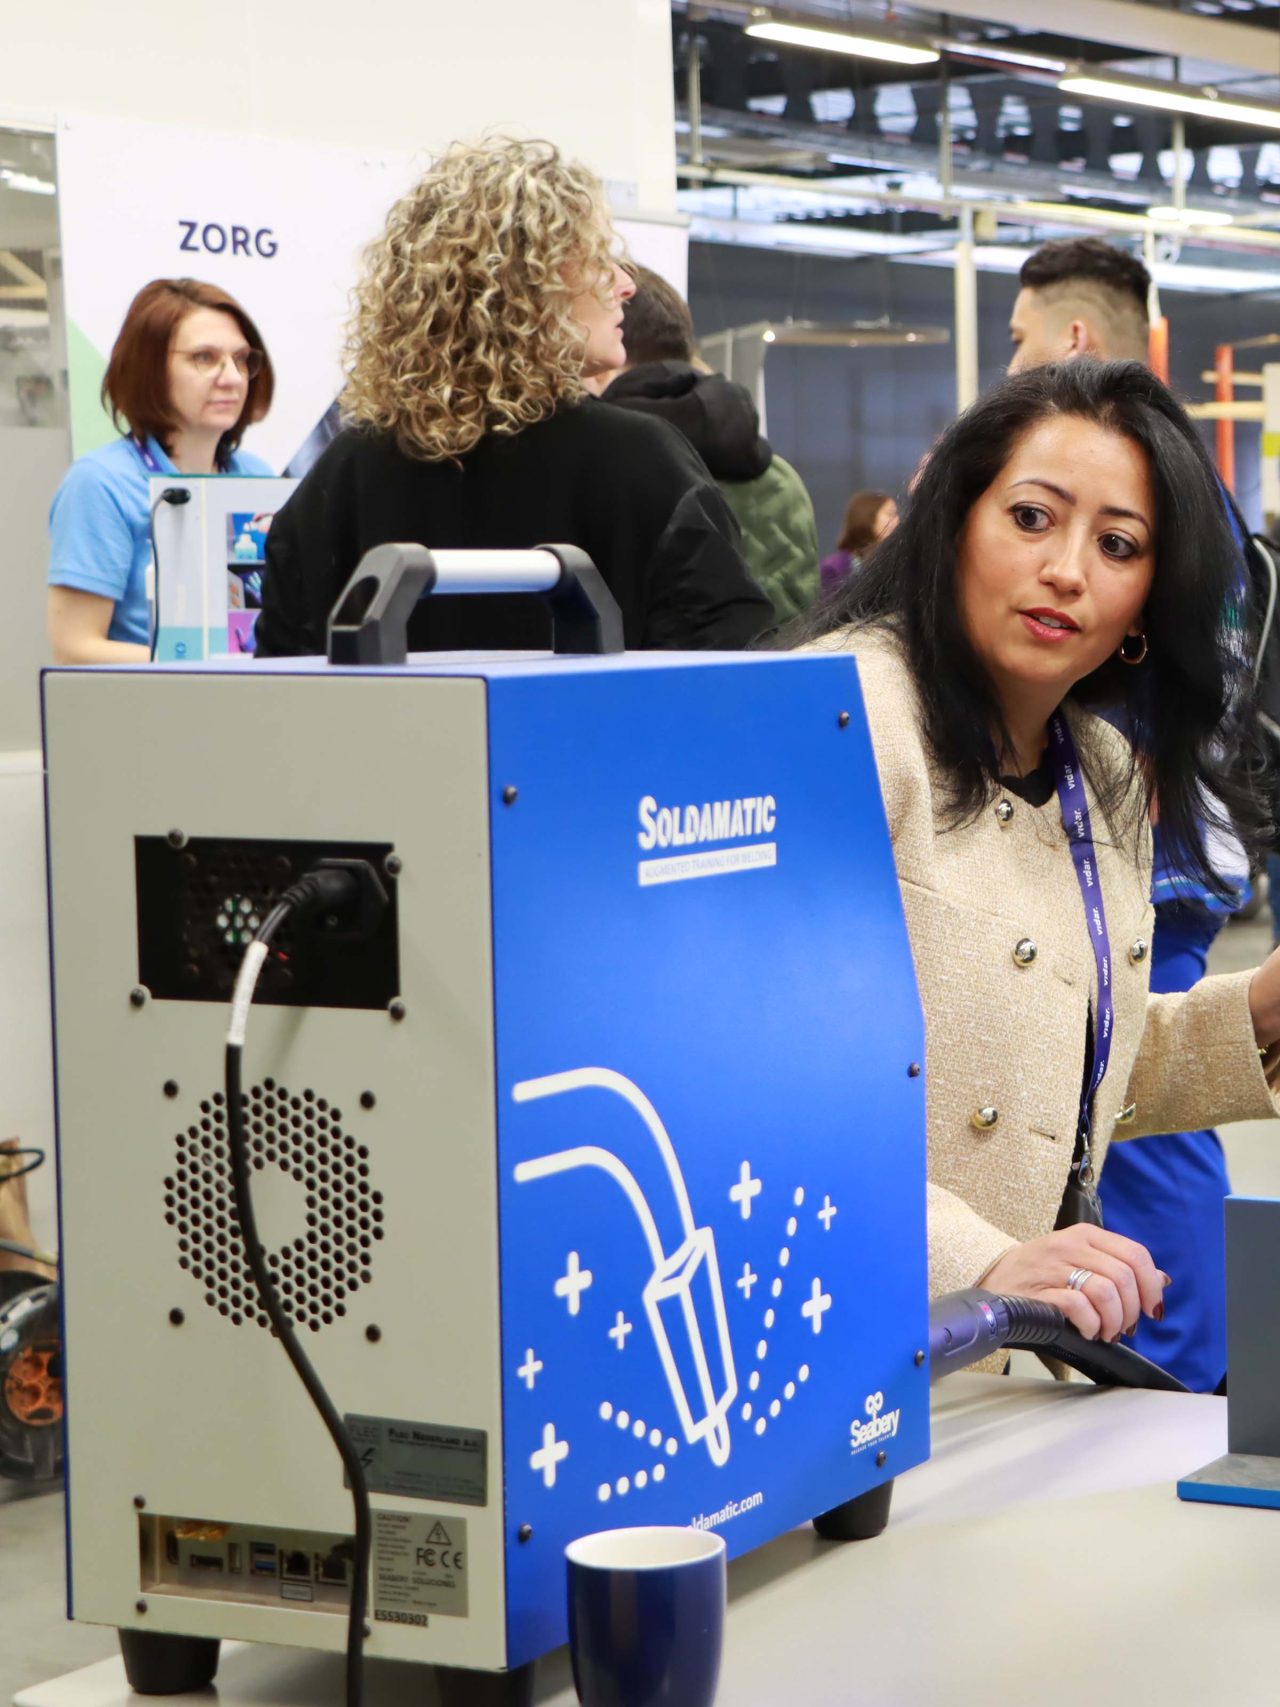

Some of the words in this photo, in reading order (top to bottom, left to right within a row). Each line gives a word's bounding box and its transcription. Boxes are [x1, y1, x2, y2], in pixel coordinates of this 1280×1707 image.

[178, 220, 279, 259] ZORG
[1082, 857, 1094, 887] vidar.
[1093, 906, 1103, 936] vidar.
[851, 1408, 900, 1448] Seabery
[687, 1491, 763, 1530] ldamatic.com
